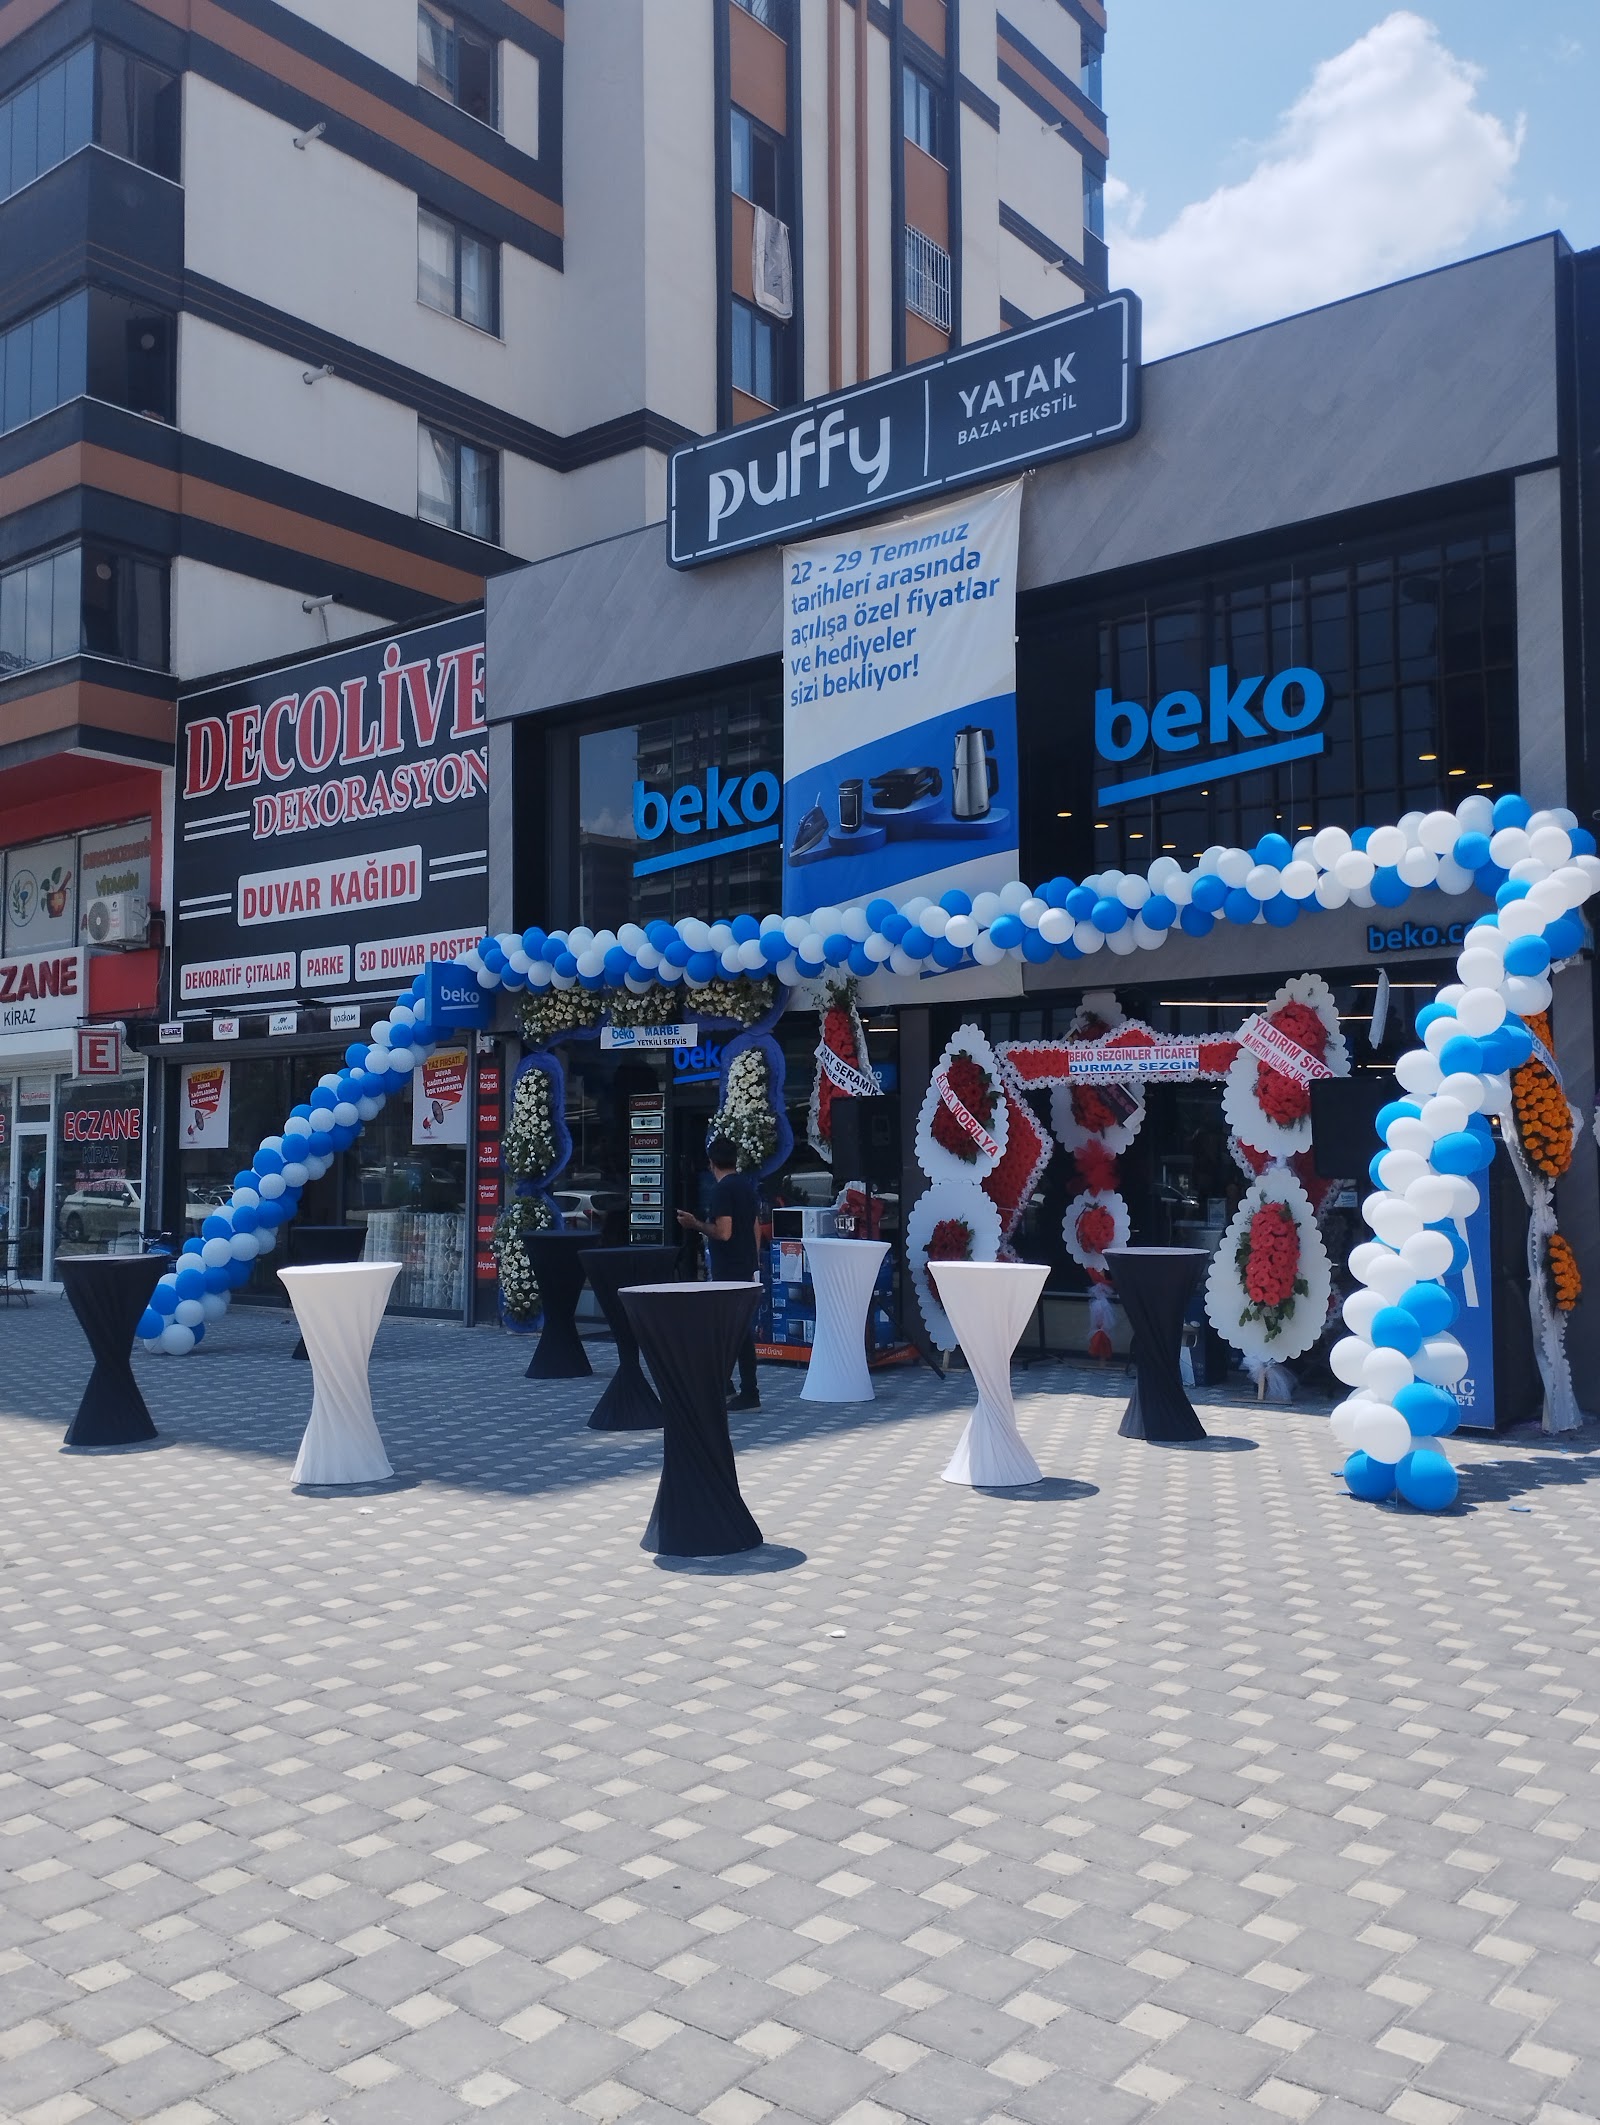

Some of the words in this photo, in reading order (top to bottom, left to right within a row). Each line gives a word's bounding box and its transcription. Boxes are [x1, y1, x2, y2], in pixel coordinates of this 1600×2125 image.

[958, 351, 1077, 419] YATAK
[708, 408, 891, 542] puffy
[790, 560, 813, 586] 22
[833, 550, 862, 575] 29
[870, 522, 970, 566] Temmuz
[791, 571, 872, 616] tarihleri
[875, 546, 982, 592] arasında
[791, 613, 848, 649] açılışa
[853, 593, 900, 627] özel
[906, 576, 1000, 617] fiyatlar
[790, 655, 811, 676] ve
[814, 625, 917, 668] hediyeler
[790, 676, 819, 707] sizi
[822, 653, 920, 698] bekliyor!
[183, 642, 487, 800] DECOLİVE
[1094, 664, 1325, 763] beko
[253, 746, 488, 840] DEKORASYON
[632, 766, 781, 841] beko
[243, 877, 321, 920] DUVAR
[330, 858, 417, 907] KAĞIDI
[306, 954, 345, 978] PARKE
[359, 952, 377, 972] 3D
[381, 945, 426, 969] DUVAR
[185, 963, 242, 990] DEKORATİF
[245, 961, 291, 989] ÇITALAR
[440, 985, 480, 1004] beko
[3, 1006, 37, 1027] KİRAZ
[611, 1027, 635, 1040] beko
[644, 1025, 680, 1037] MARBE
[663, 1036, 687, 1046] SERVİS
[1252, 1018, 1303, 1061] YILDIRIM
[88, 1038, 110, 1069] E
[427, 1060, 440, 1069] YAZ
[439, 1056, 462, 1067] FIRSATI
[673, 1040, 721, 1070] bek
[1069, 1050, 1094, 1063] BEKO
[1096, 1048, 1151, 1061] SEZGİNLER
[1153, 1047, 1199, 1059] TİCARET
[1069, 1063, 1134, 1073] DURMAZ
[1138, 1060, 1199, 1072] SEZGİN
[1268, 1052, 1296, 1078] YILMAZ
[435, 1068, 452, 1078] DUVAR
[480, 1073, 497, 1081] Duvar
[480, 1081, 498, 1091] Kağıdı
[63, 1108, 141, 1142] ECZANE
[480, 1114, 497, 1123] Parke
[81, 1142, 119, 1164] KİRAZ
[483, 1146, 493, 1154] 3D
[634, 1137, 659, 1145] Lenovo
[479, 1155, 498, 1164] Poster
